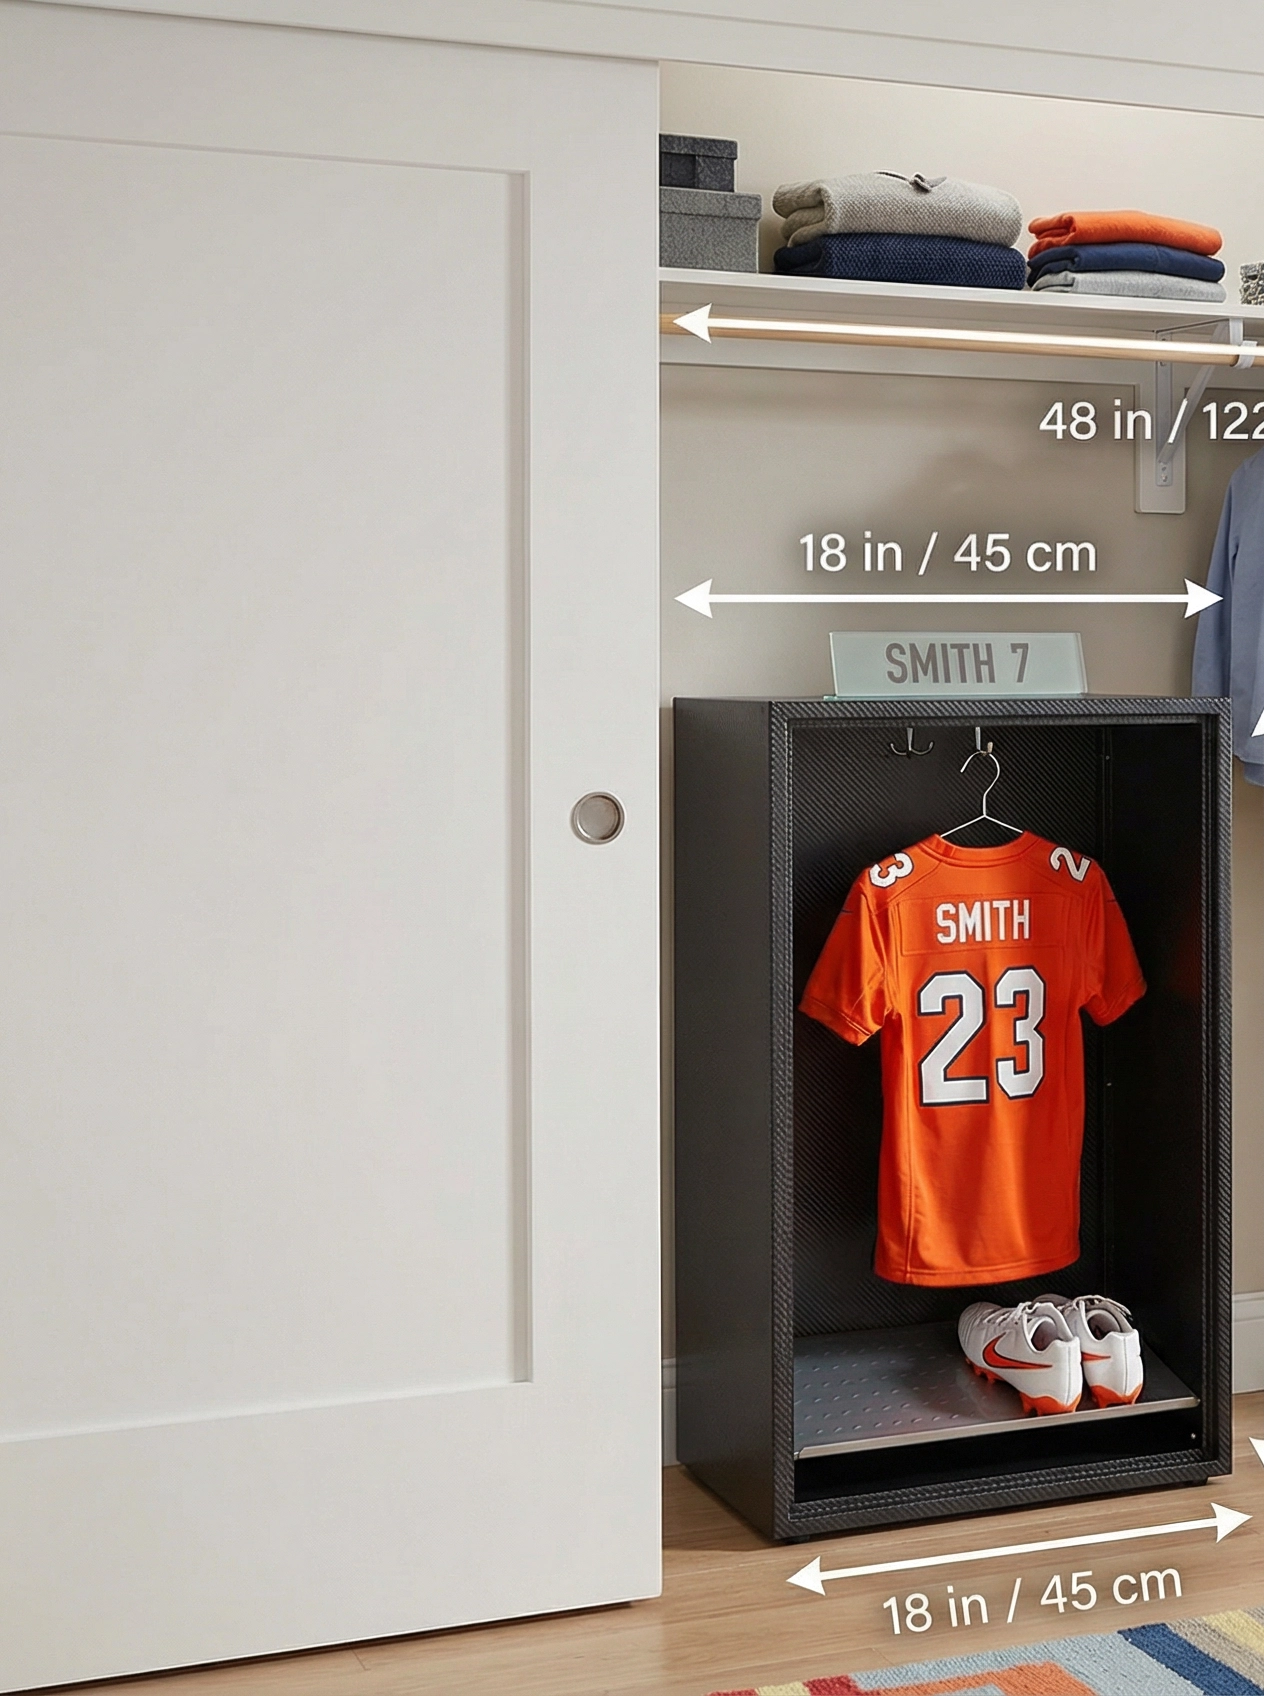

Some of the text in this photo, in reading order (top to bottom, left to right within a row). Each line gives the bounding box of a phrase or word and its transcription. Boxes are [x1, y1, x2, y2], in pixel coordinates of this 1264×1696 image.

[885, 642, 1029, 686] SMITH 7
[869, 853, 913, 889] 3
[1049, 846, 1091, 882] 2
[936, 899, 1030, 945] SMITH
[918, 966, 1046, 1105] 23
